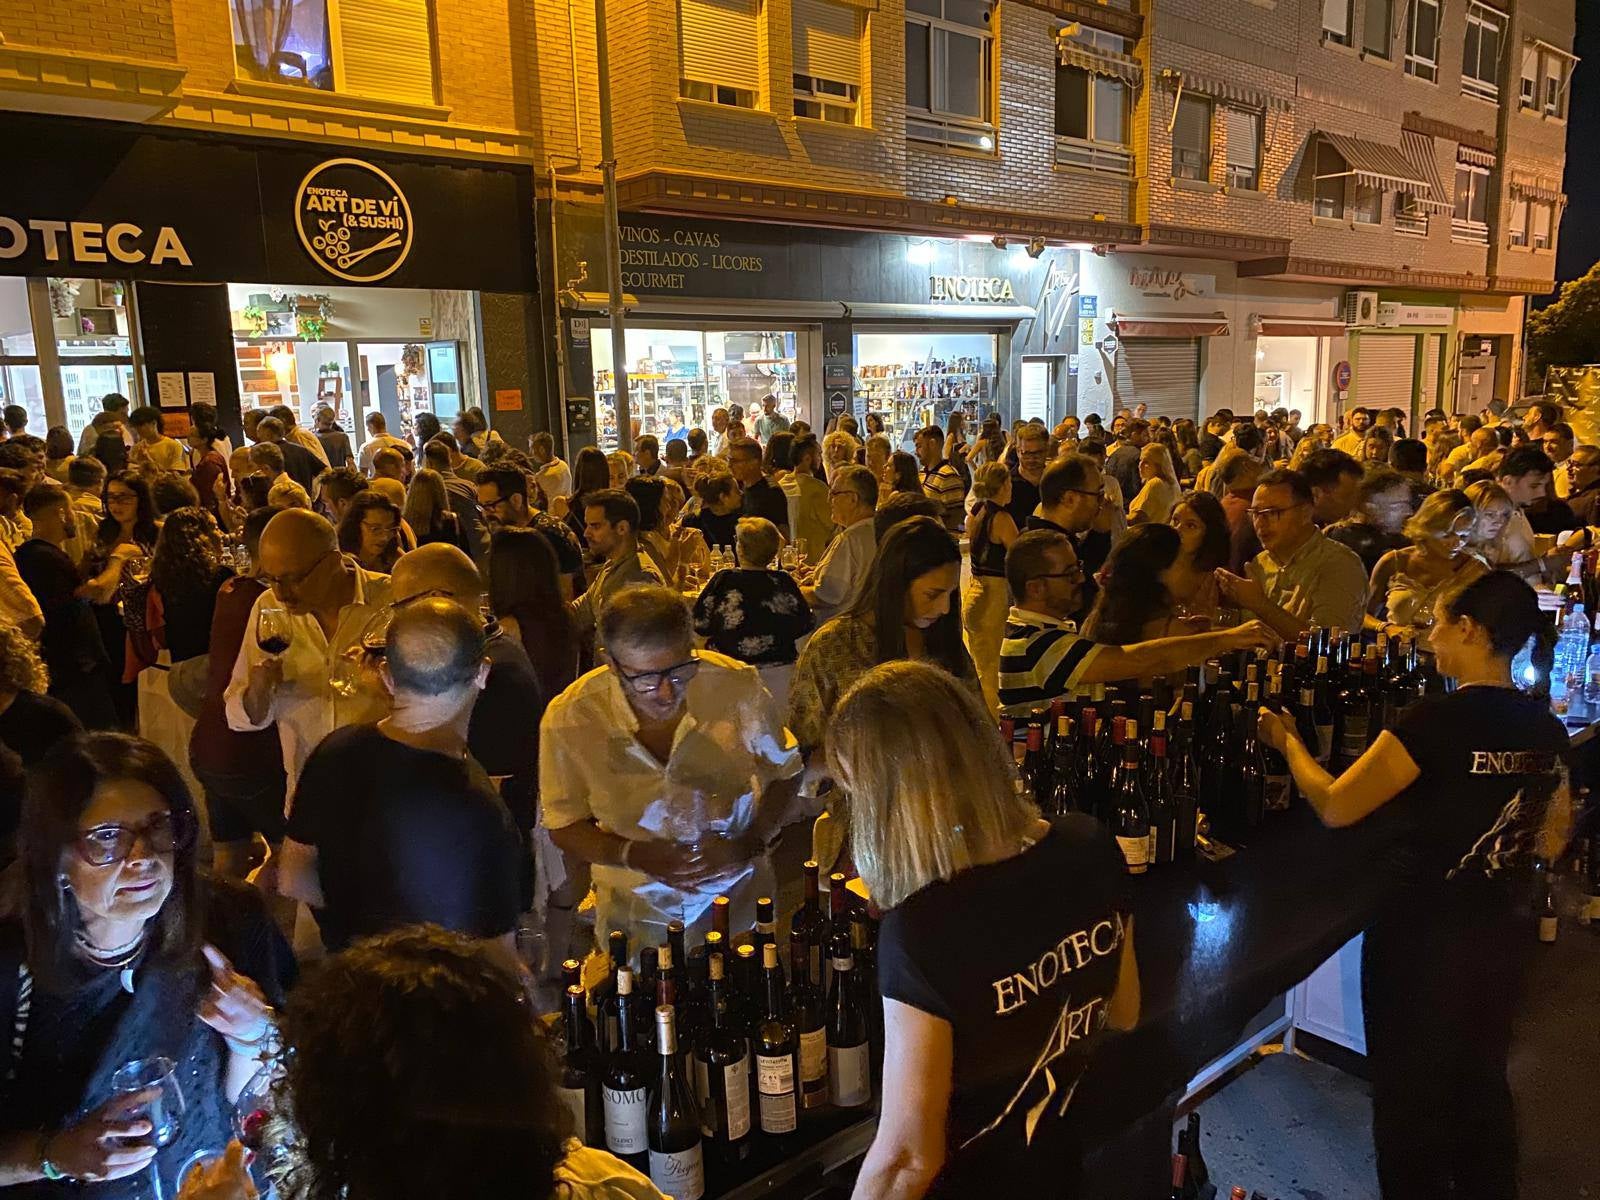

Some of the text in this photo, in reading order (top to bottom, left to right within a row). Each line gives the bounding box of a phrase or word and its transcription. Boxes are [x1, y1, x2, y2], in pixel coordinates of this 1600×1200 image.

[307, 187, 348, 197] ENOTECA
[306, 195, 348, 213] ART
[351, 198, 378, 215] DE
[618, 226, 660, 244] VINOS
[673, 230, 720, 248] CAVAS
[620, 249, 699, 269] DESTILADOS
[712, 254, 763, 272] LICORES
[621, 272, 685, 289] GOURMET
[930, 275, 1015, 302] ENOTECA
[825, 342, 838, 357] 15
